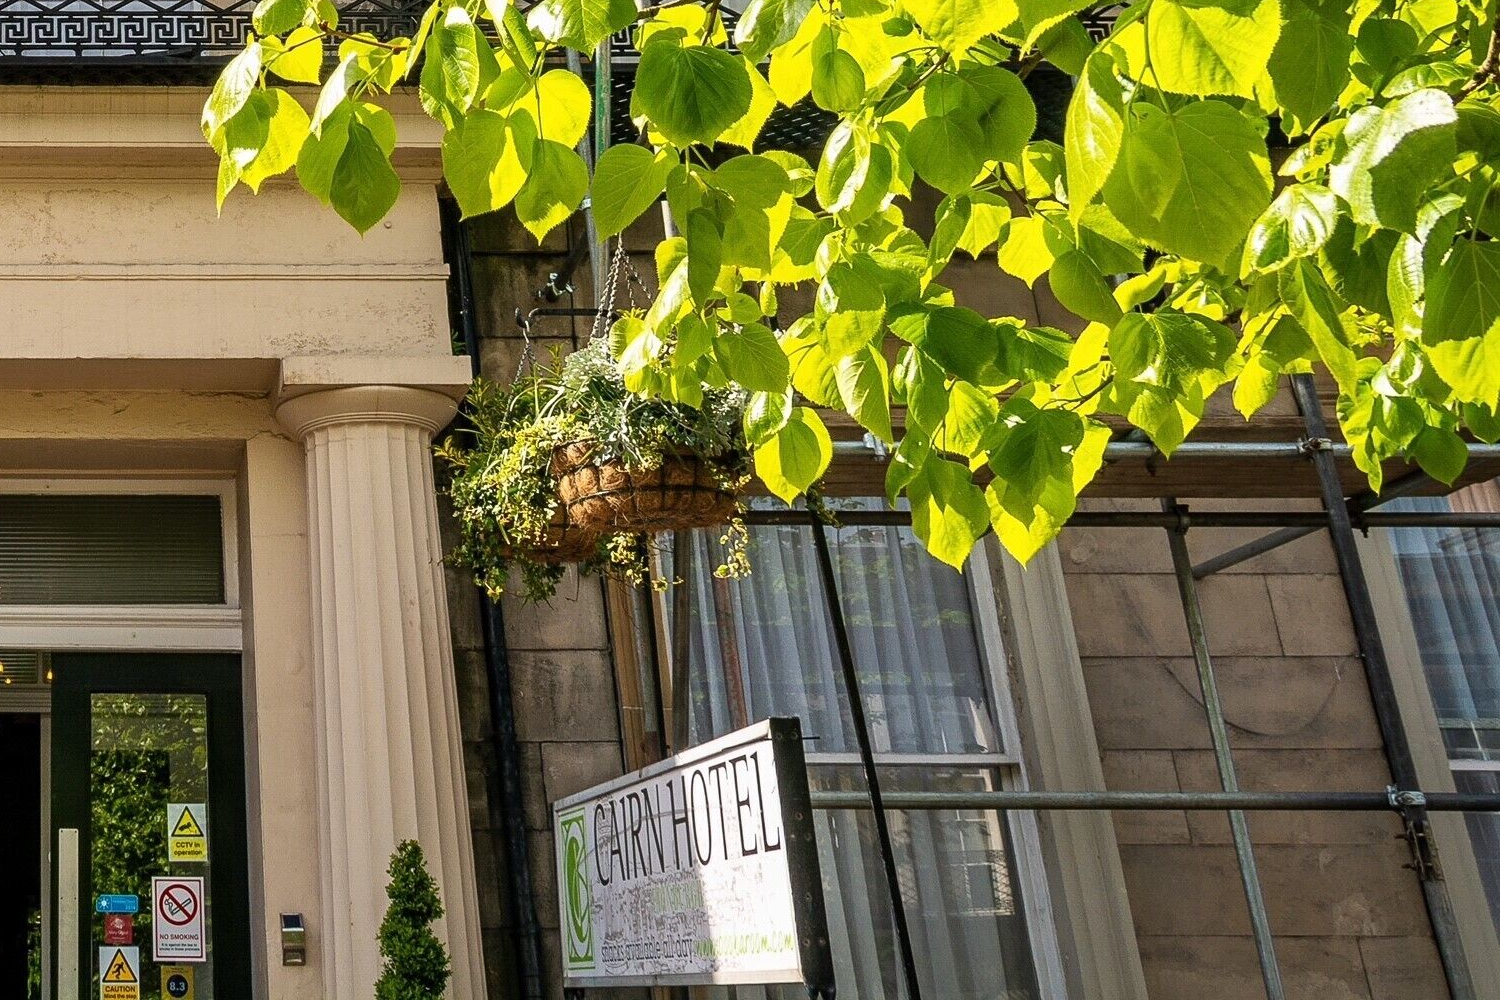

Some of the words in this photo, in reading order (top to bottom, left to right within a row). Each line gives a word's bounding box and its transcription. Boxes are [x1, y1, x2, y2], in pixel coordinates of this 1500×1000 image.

[593, 784, 665, 886] CAIRN
[666, 752, 781, 867] HOTEL
[674, 934, 694, 964] day
[104, 985, 136, 993] CAUTION
[169, 981, 185, 991] 8.3
